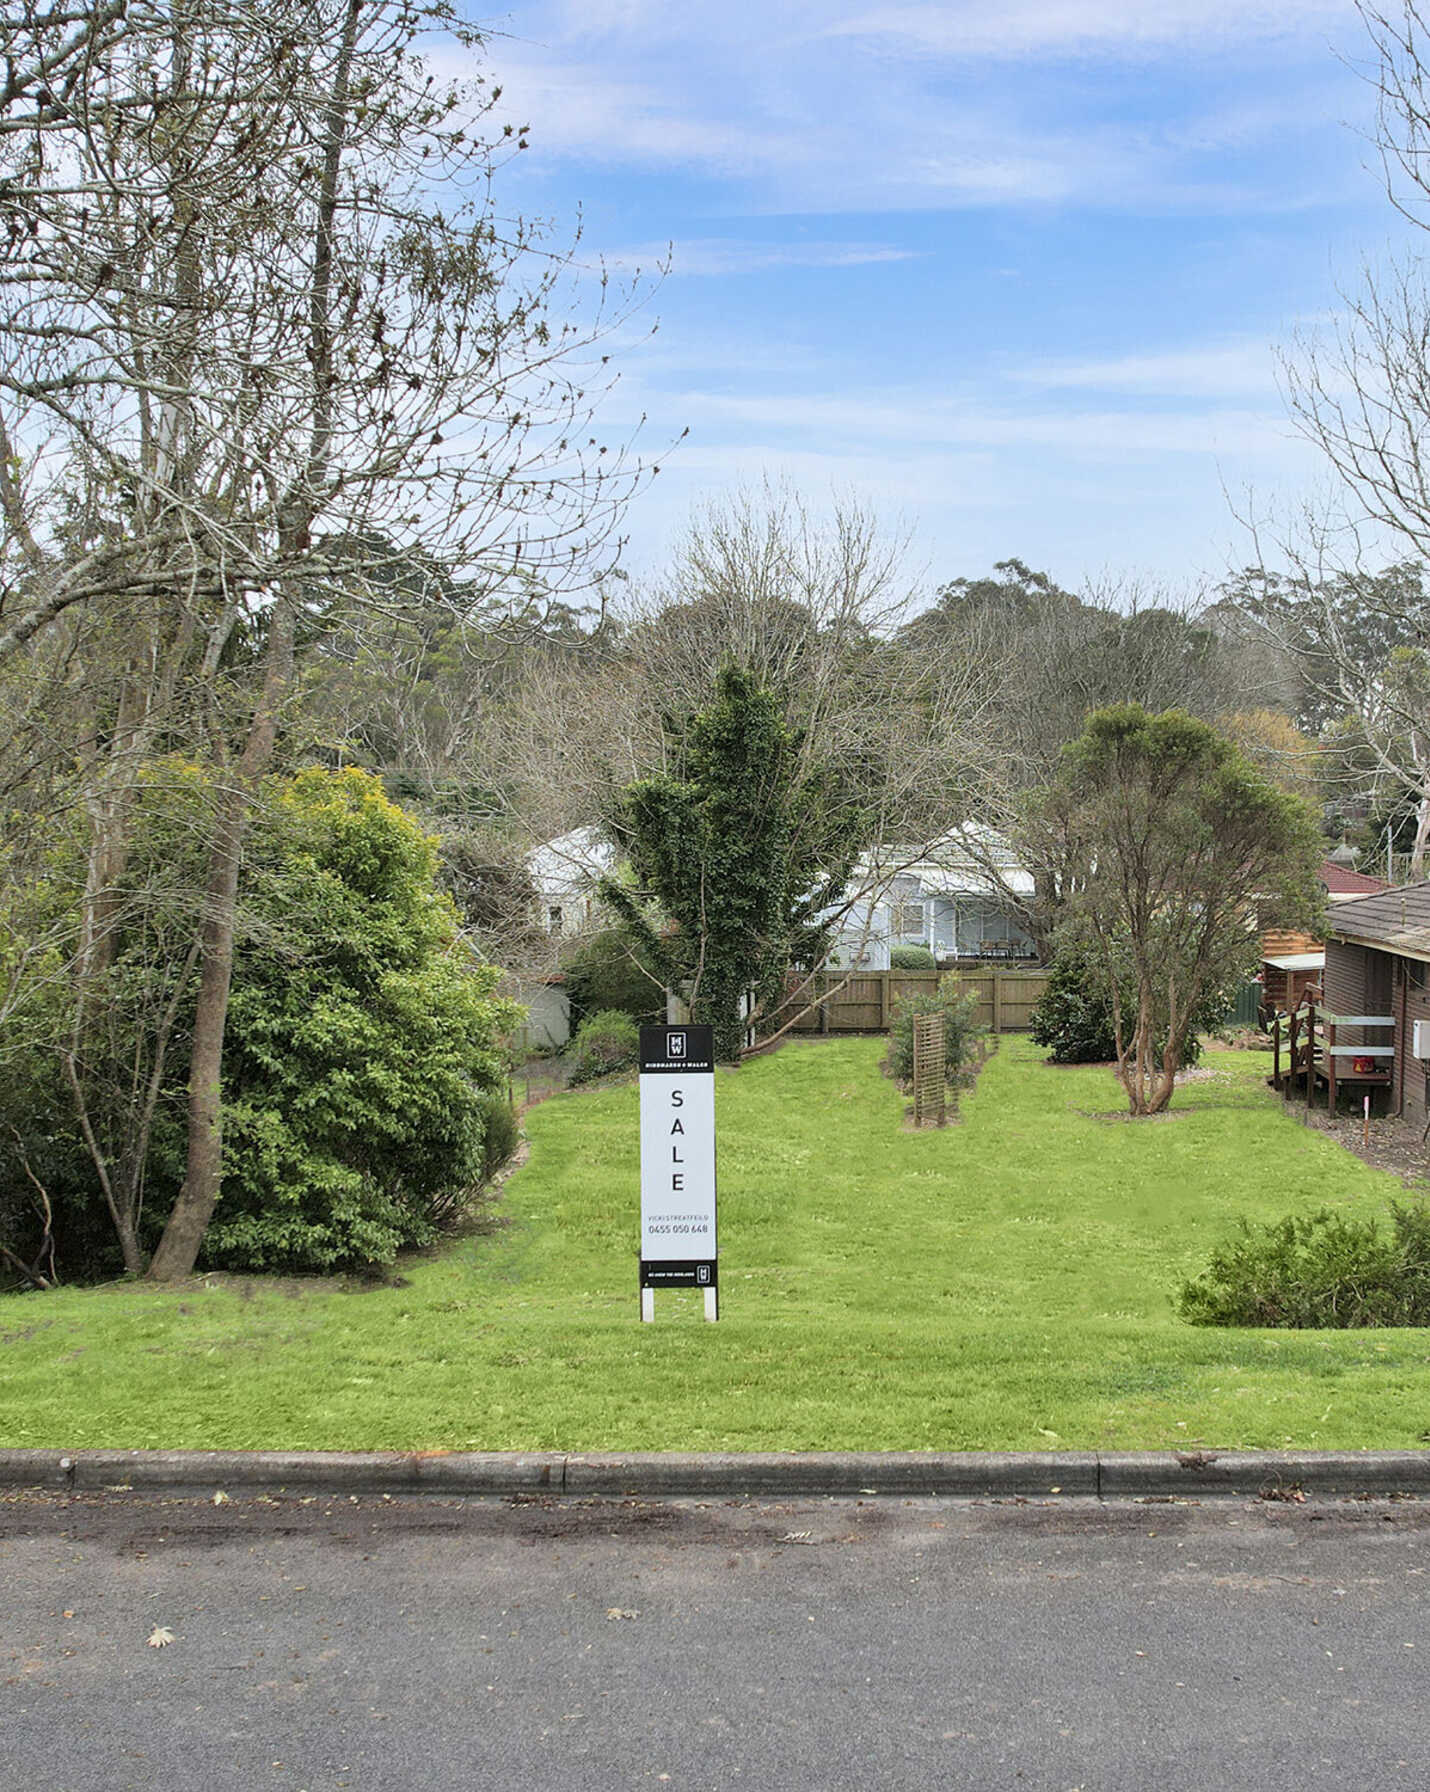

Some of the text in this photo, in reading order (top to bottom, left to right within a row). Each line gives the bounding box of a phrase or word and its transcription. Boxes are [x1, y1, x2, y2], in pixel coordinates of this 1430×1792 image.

[670, 1090, 685, 1191] SALE
[648, 1225, 671, 1234] 0455
[672, 1224, 689, 1233] 050
